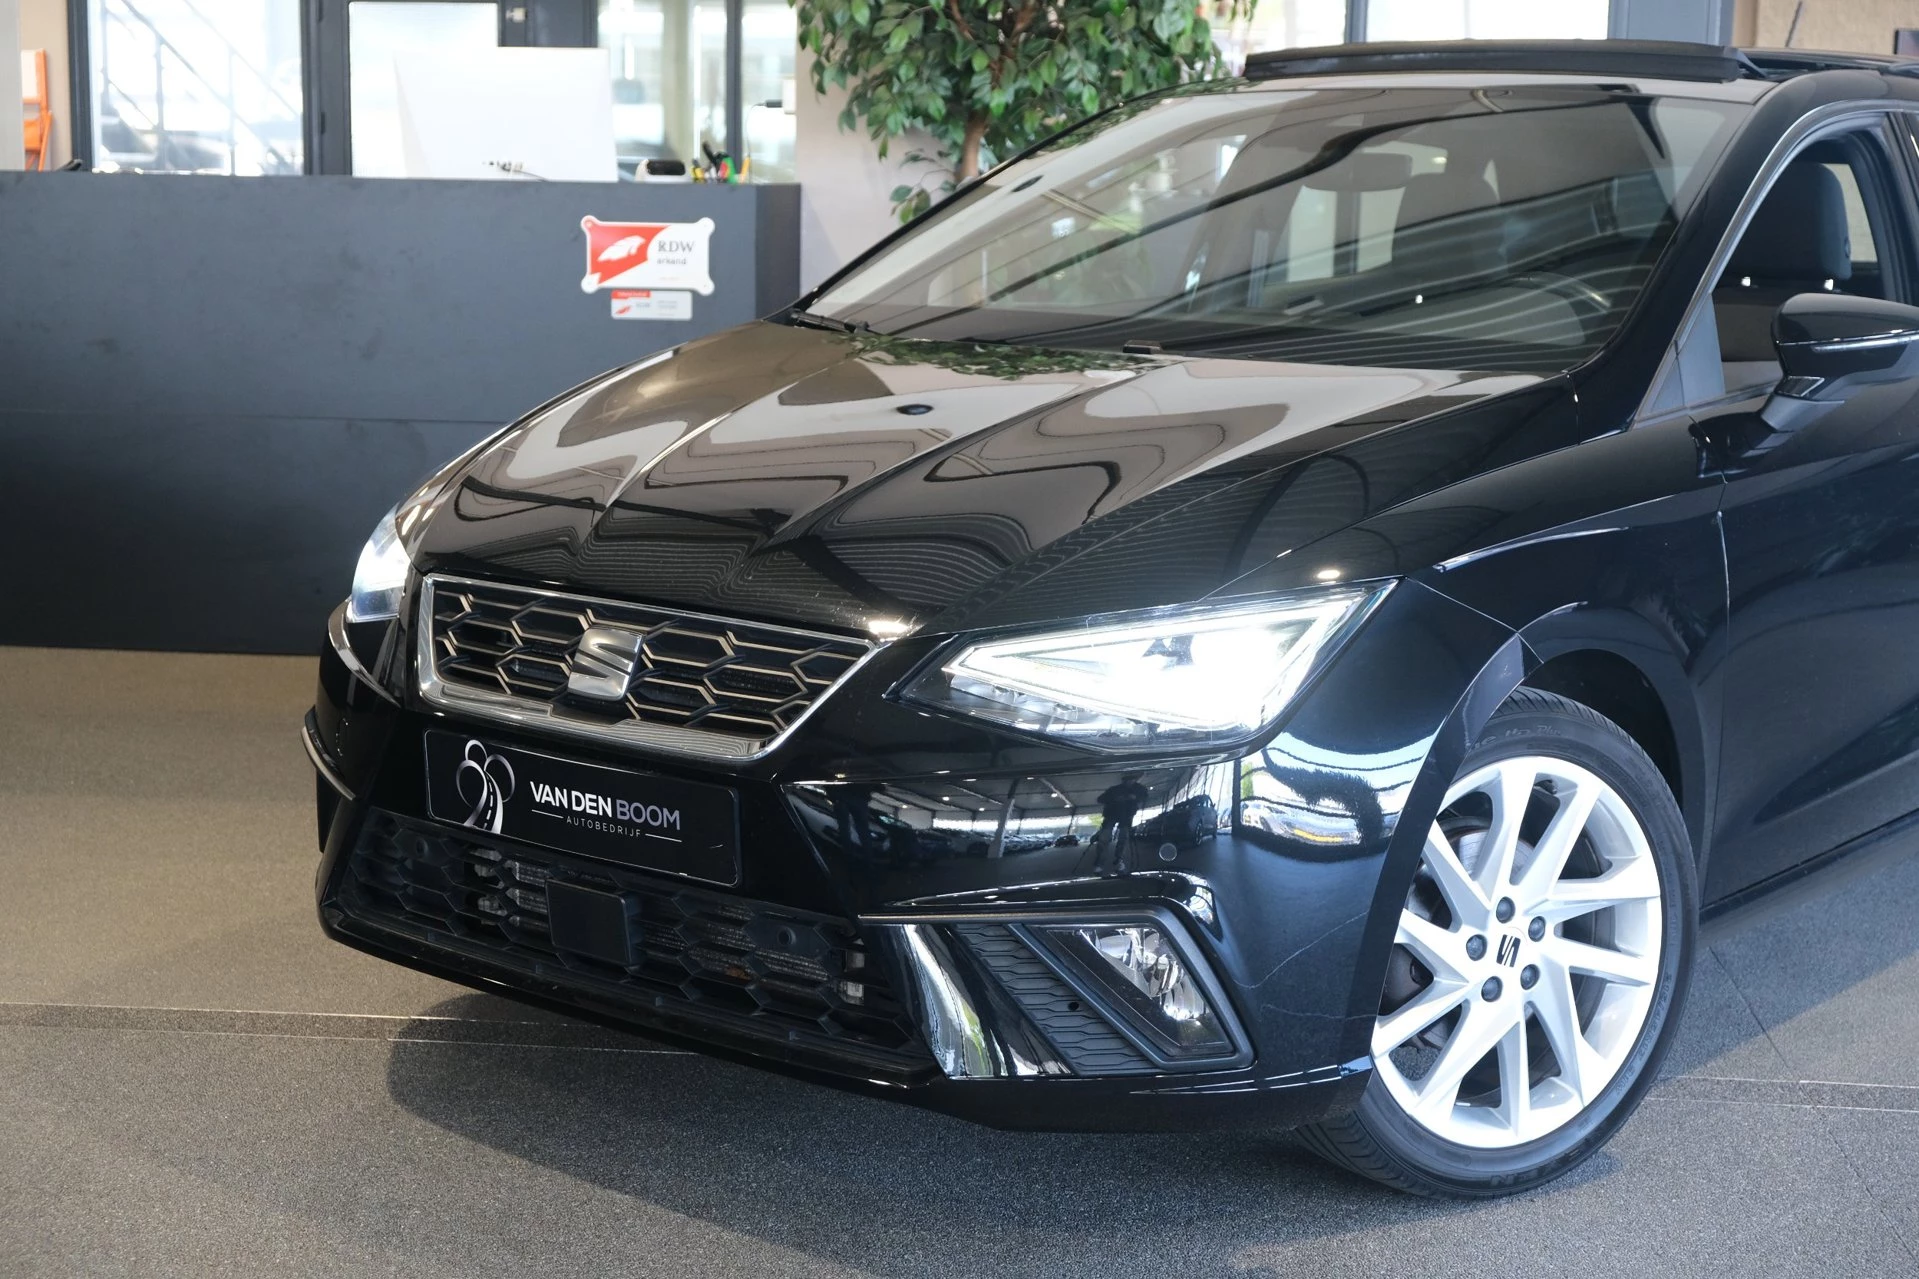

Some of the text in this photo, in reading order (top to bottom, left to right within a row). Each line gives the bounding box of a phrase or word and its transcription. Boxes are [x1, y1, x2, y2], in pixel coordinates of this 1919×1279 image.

[657, 239, 695, 253] RDW
[529, 780, 681, 831] VAN DEN BOOM
[565, 815, 642, 838] AUTOBEDRIJF
